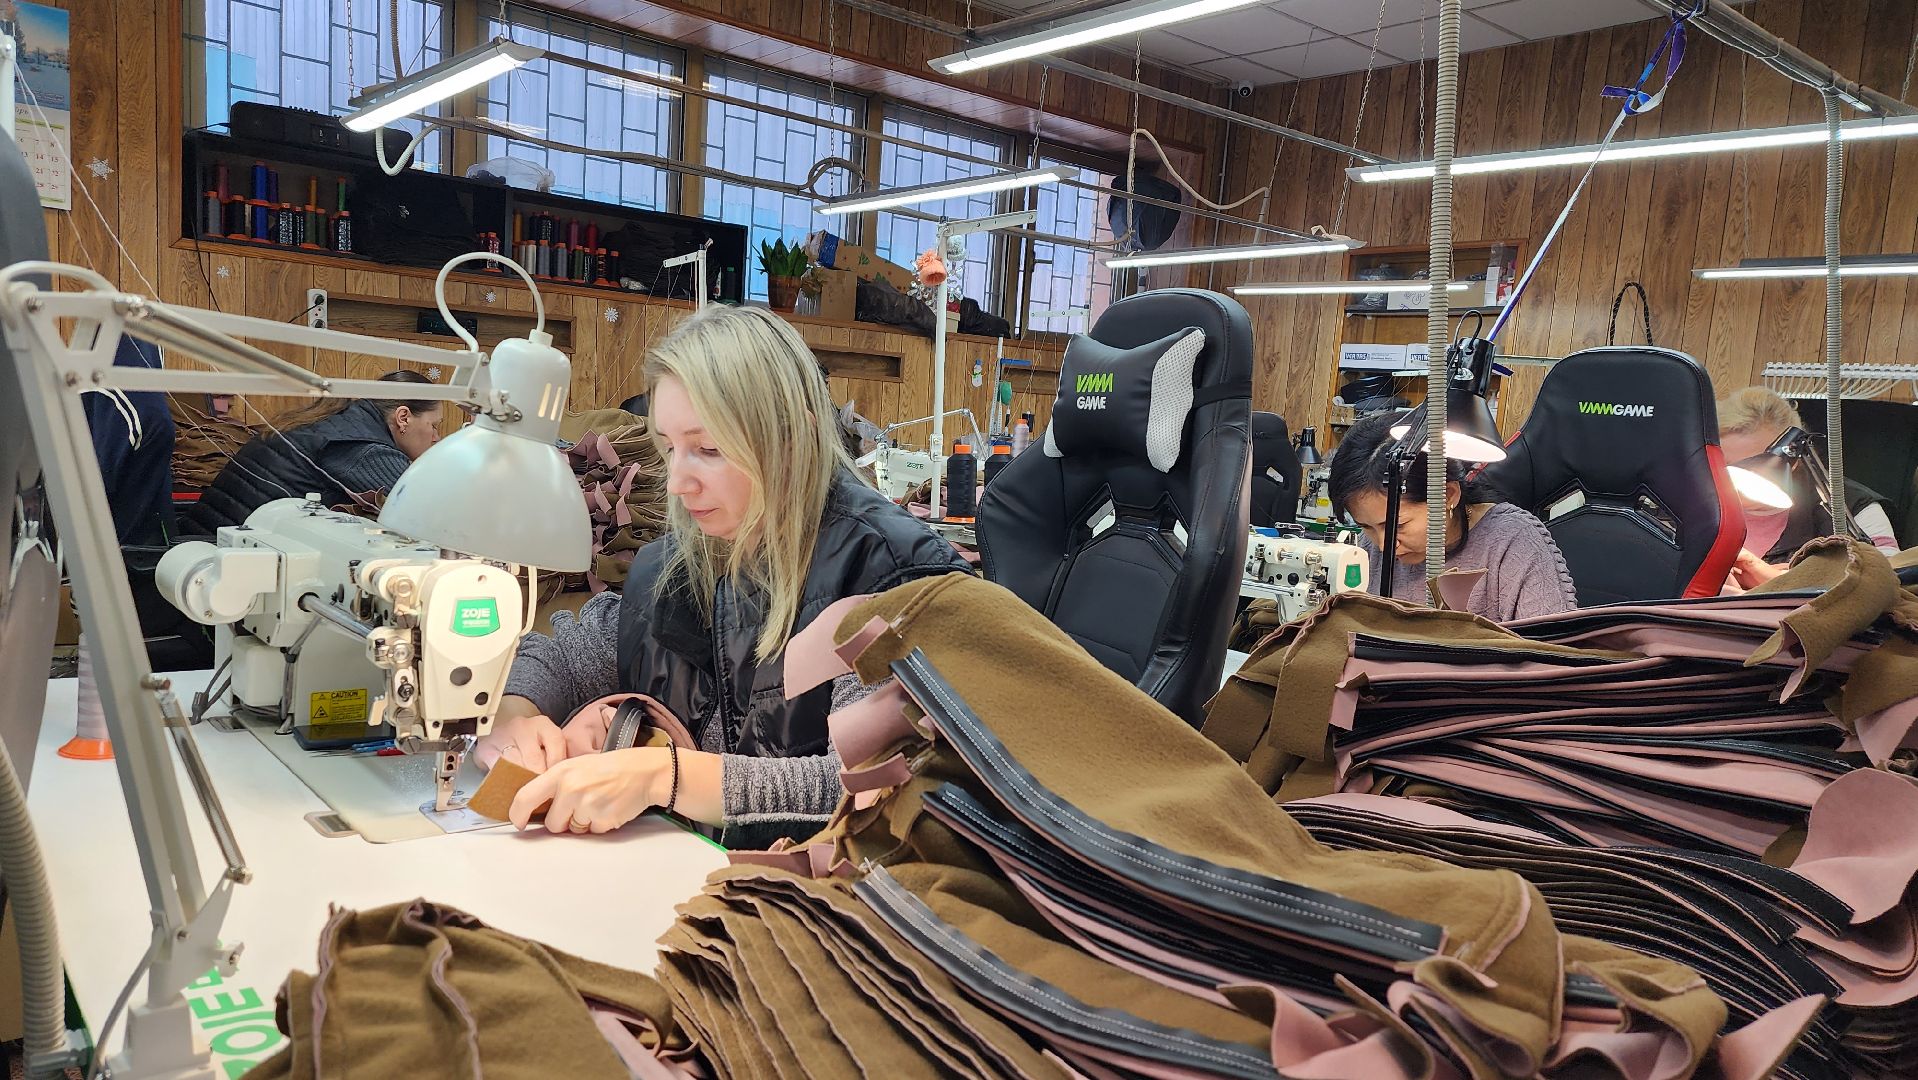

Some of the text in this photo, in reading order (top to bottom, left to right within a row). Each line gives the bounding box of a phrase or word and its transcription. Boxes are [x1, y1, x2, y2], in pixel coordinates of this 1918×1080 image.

[1076, 395, 1107, 411] GAME
[461, 607, 491, 619] ZOJE
[330, 690, 359, 699] CAUTION
